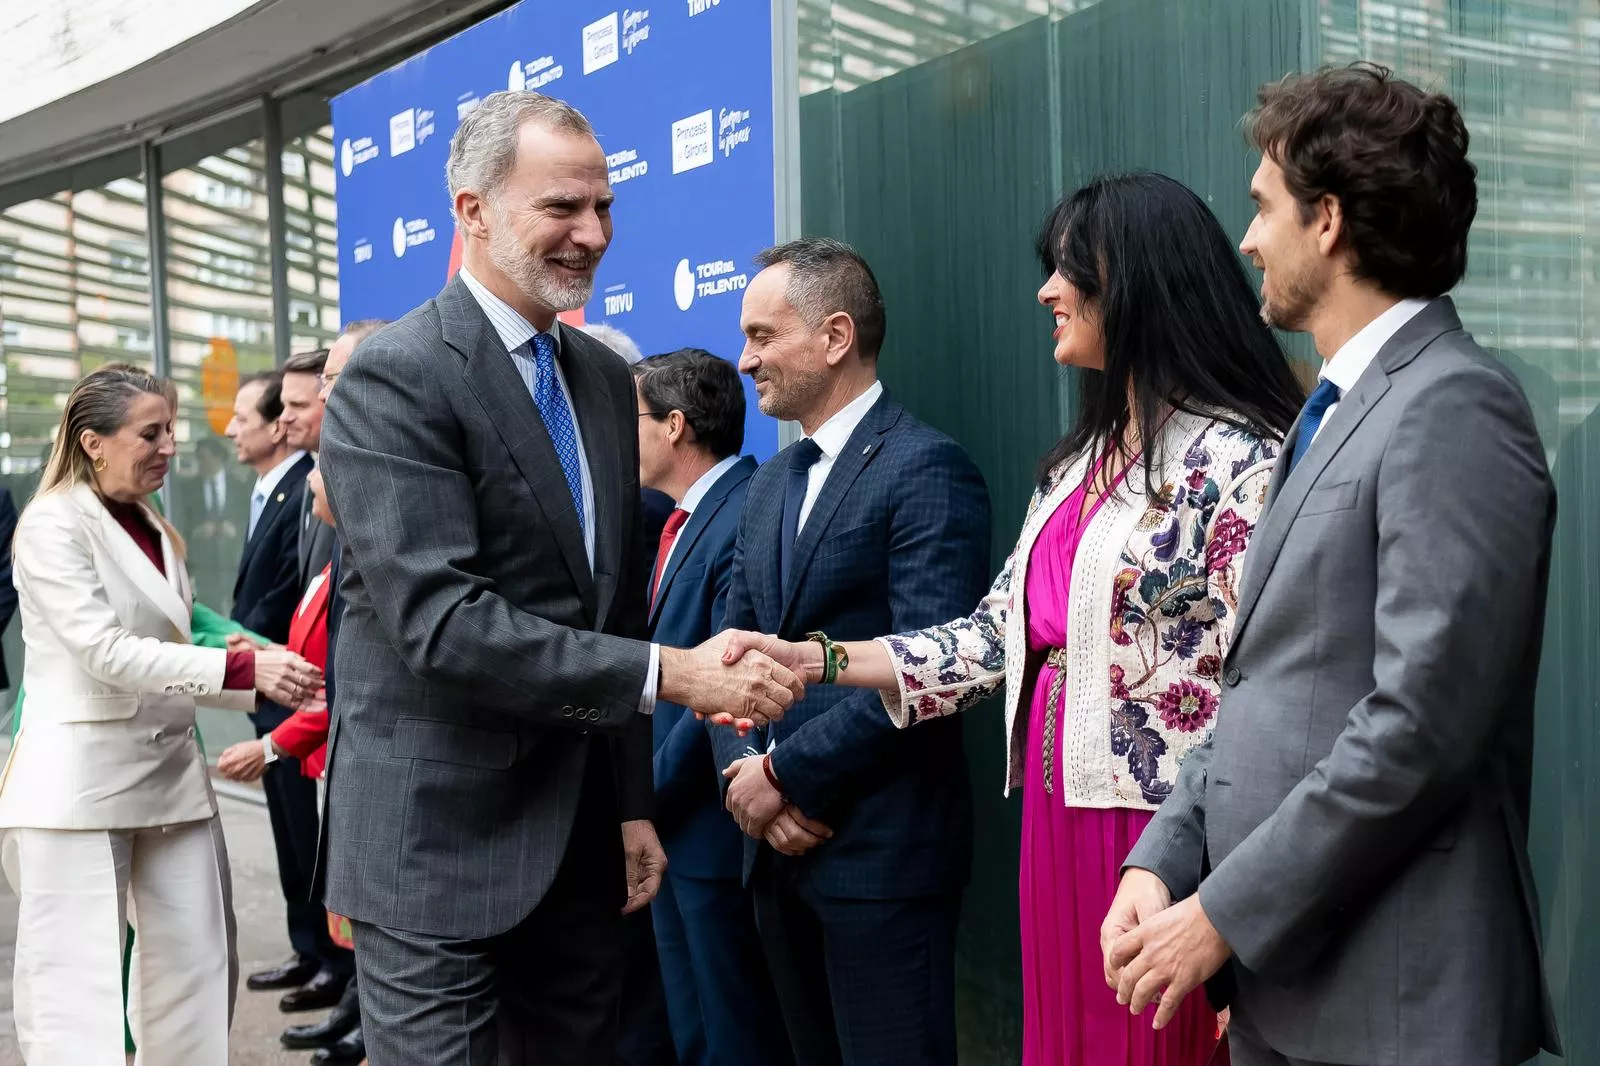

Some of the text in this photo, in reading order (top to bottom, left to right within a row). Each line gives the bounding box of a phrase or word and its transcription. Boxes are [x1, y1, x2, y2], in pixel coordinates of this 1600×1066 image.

[687, 0, 721, 17] TRI
[696, 260, 723, 279] TOUR
[697, 273, 747, 298] TALENTO
[604, 291, 633, 316] TRIVU
